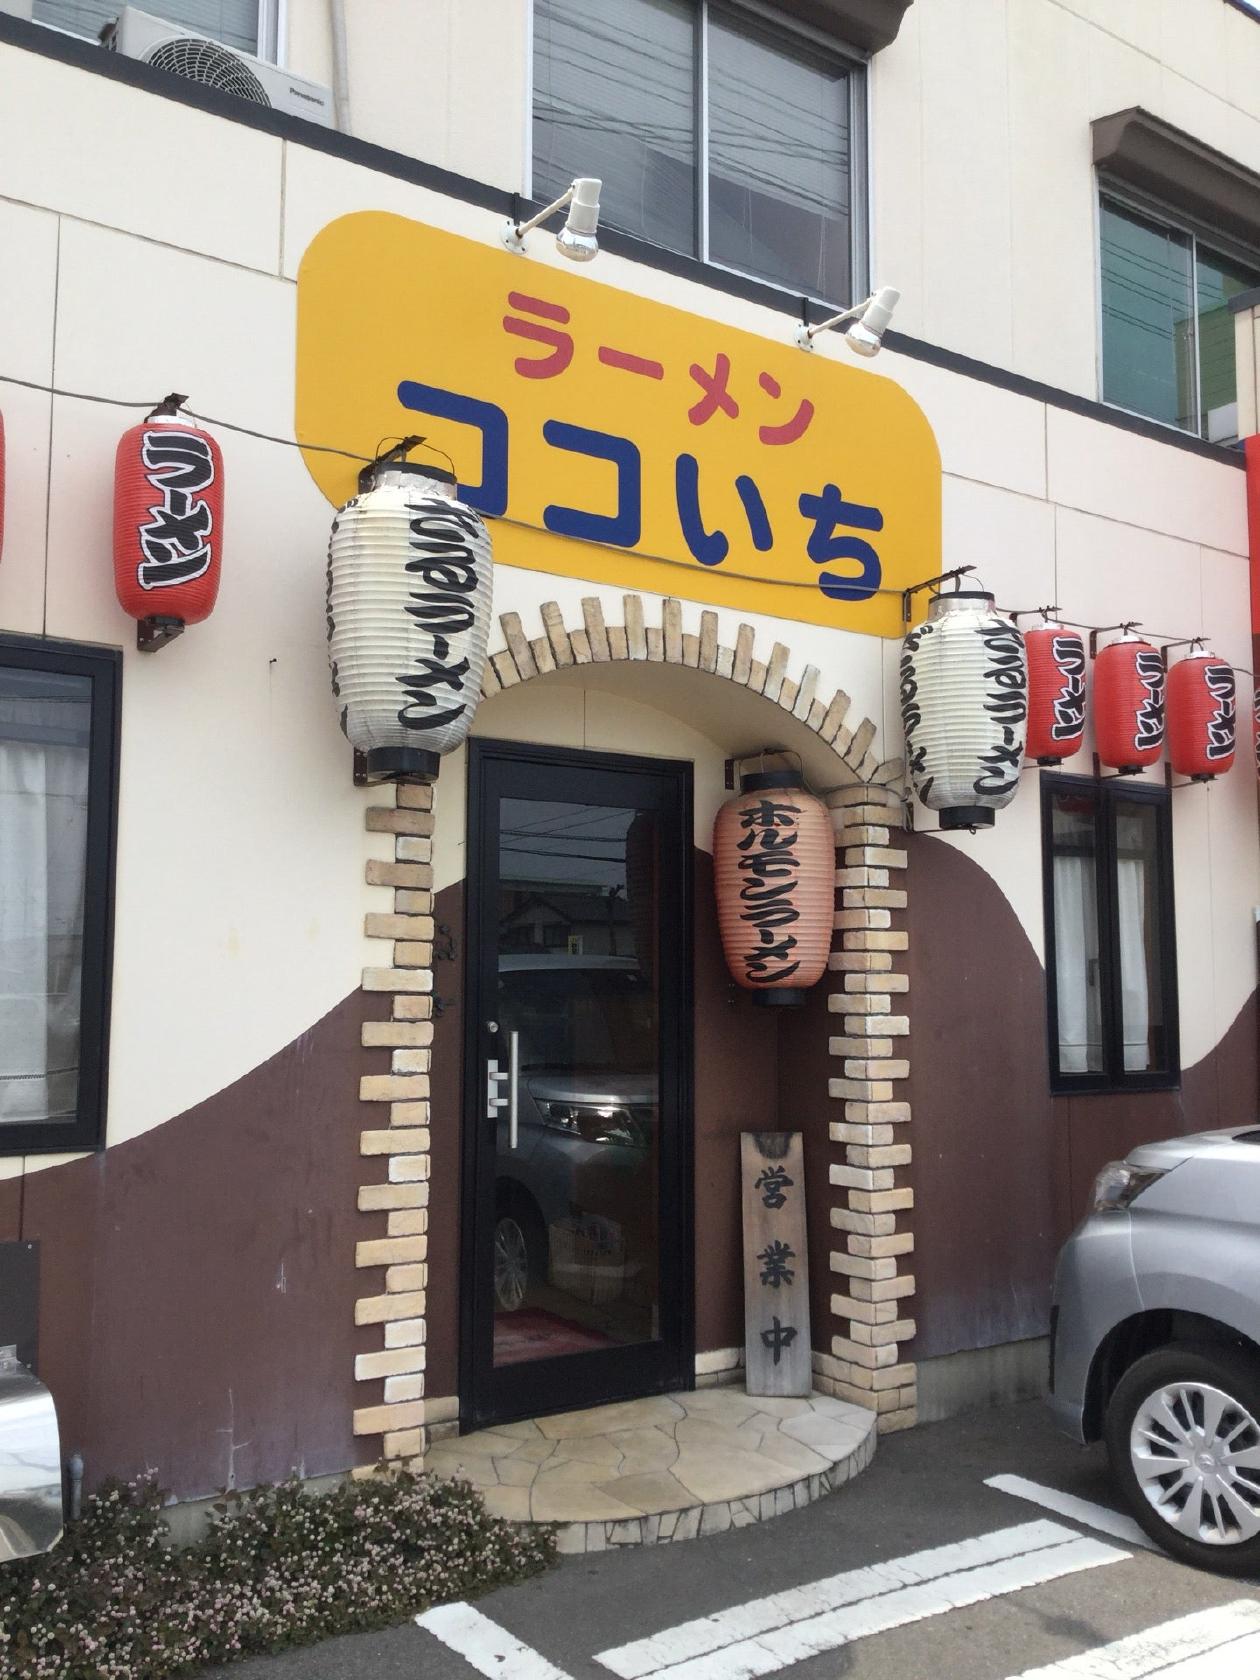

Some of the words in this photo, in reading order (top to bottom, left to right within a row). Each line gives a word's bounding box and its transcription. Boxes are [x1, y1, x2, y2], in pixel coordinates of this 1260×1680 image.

[503, 290, 814, 446] ラーメン
[137, 430, 215, 591] ラーメン
[397, 380, 884, 601] ココいち
[1052, 635, 1086, 742] ラーメン
[1135, 651, 1165, 752] ラーメン
[1205, 665, 1236, 760] ラーメン
[737, 800, 802, 984] ホルモンラーメン
[754, 1165, 798, 1366] 営業中
